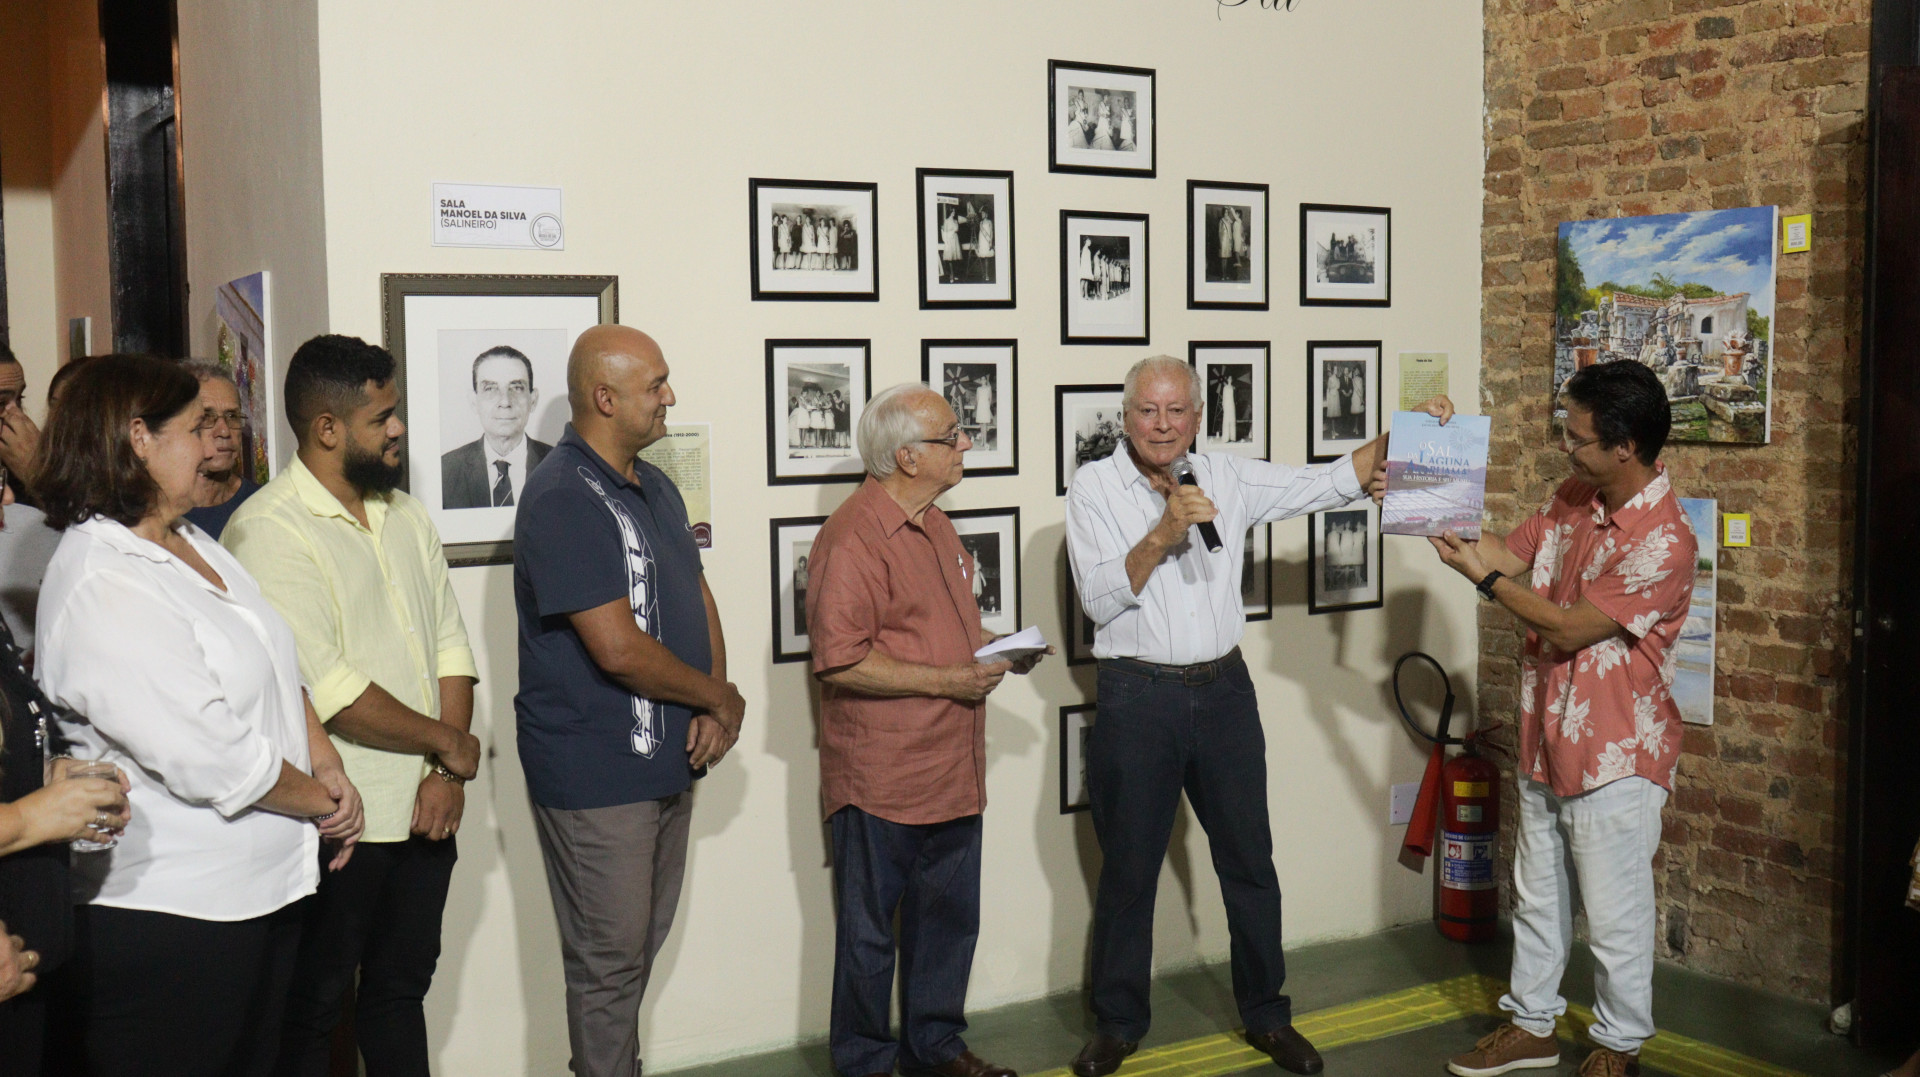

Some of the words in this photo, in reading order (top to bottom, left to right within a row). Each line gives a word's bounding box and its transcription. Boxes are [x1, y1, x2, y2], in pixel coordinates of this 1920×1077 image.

[440, 199, 466, 209] SALA
[440, 209, 482, 219] MANOEL
[484, 211, 498, 219] DA
[500, 212, 527, 220] SILVA
[440, 219, 497, 229] (SALINEIRO)
[1419, 441, 1427, 450] O
